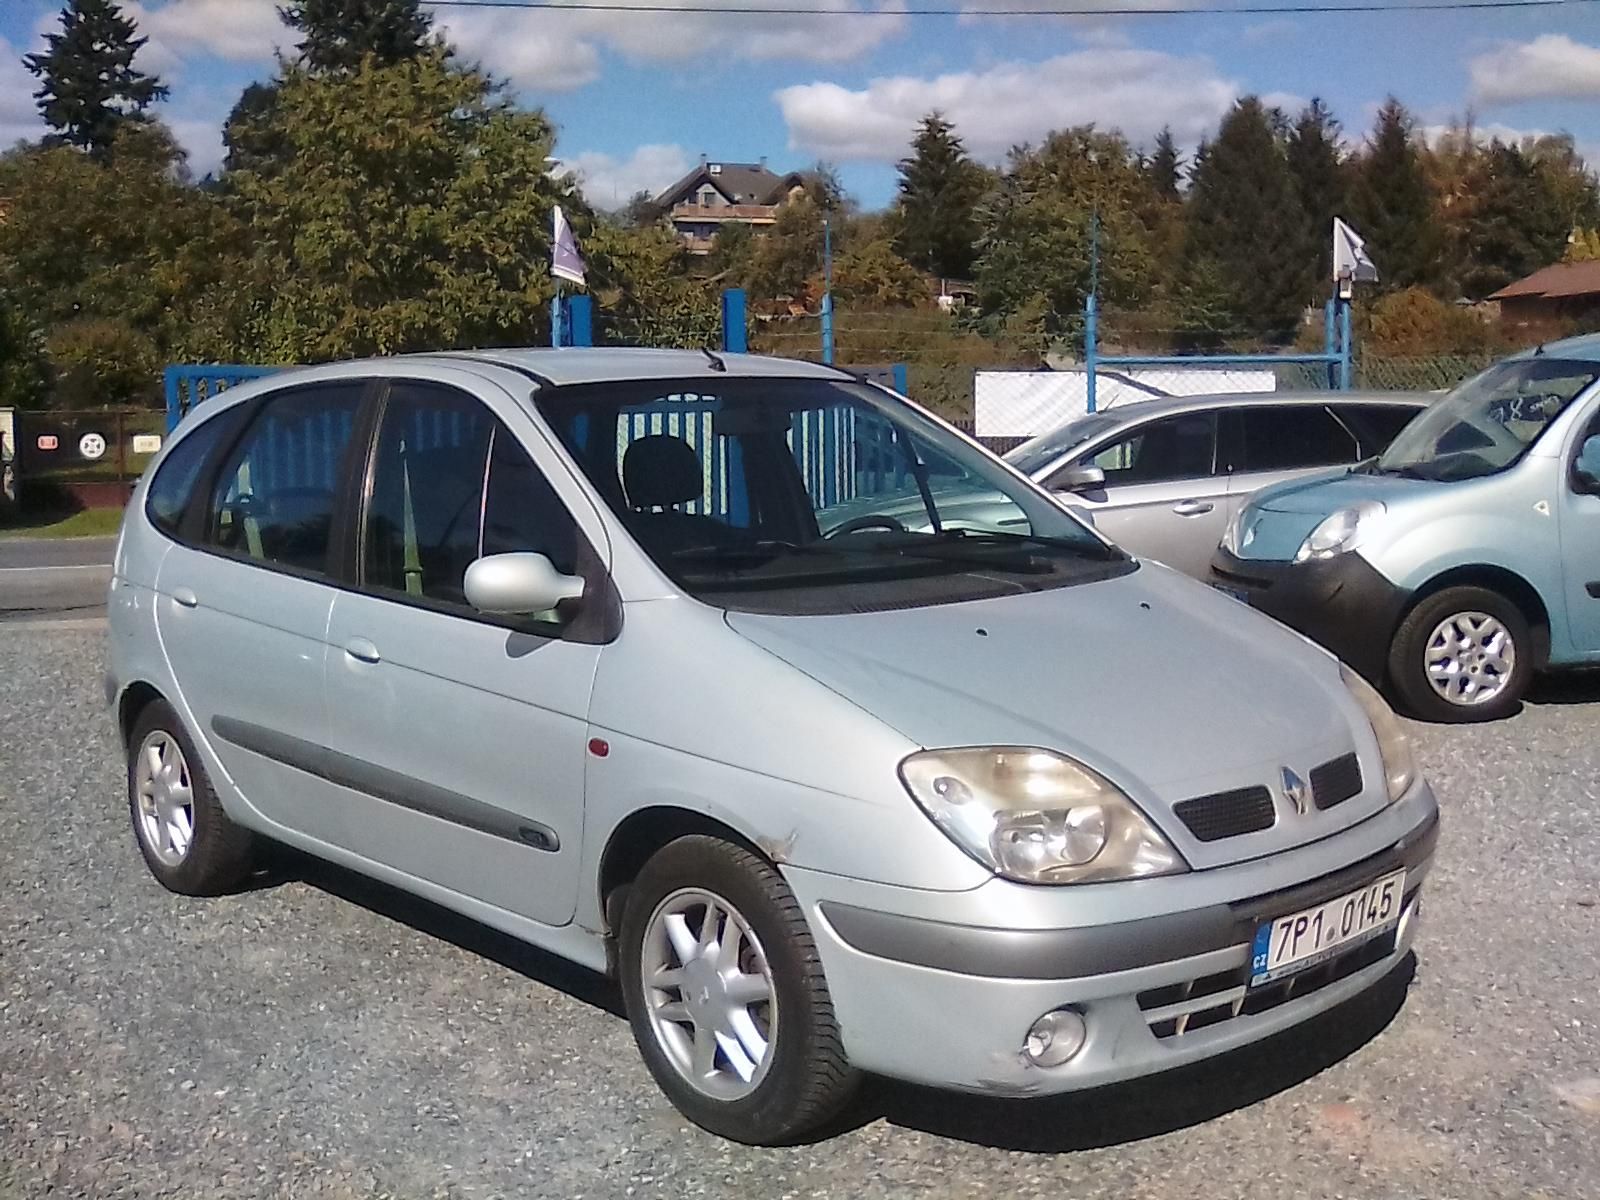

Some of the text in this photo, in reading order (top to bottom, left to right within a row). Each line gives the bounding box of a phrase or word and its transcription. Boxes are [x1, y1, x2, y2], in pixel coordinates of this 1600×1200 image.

[1275, 880, 1395, 963] 7P1 0145
[1252, 953, 1267, 971] CZ
